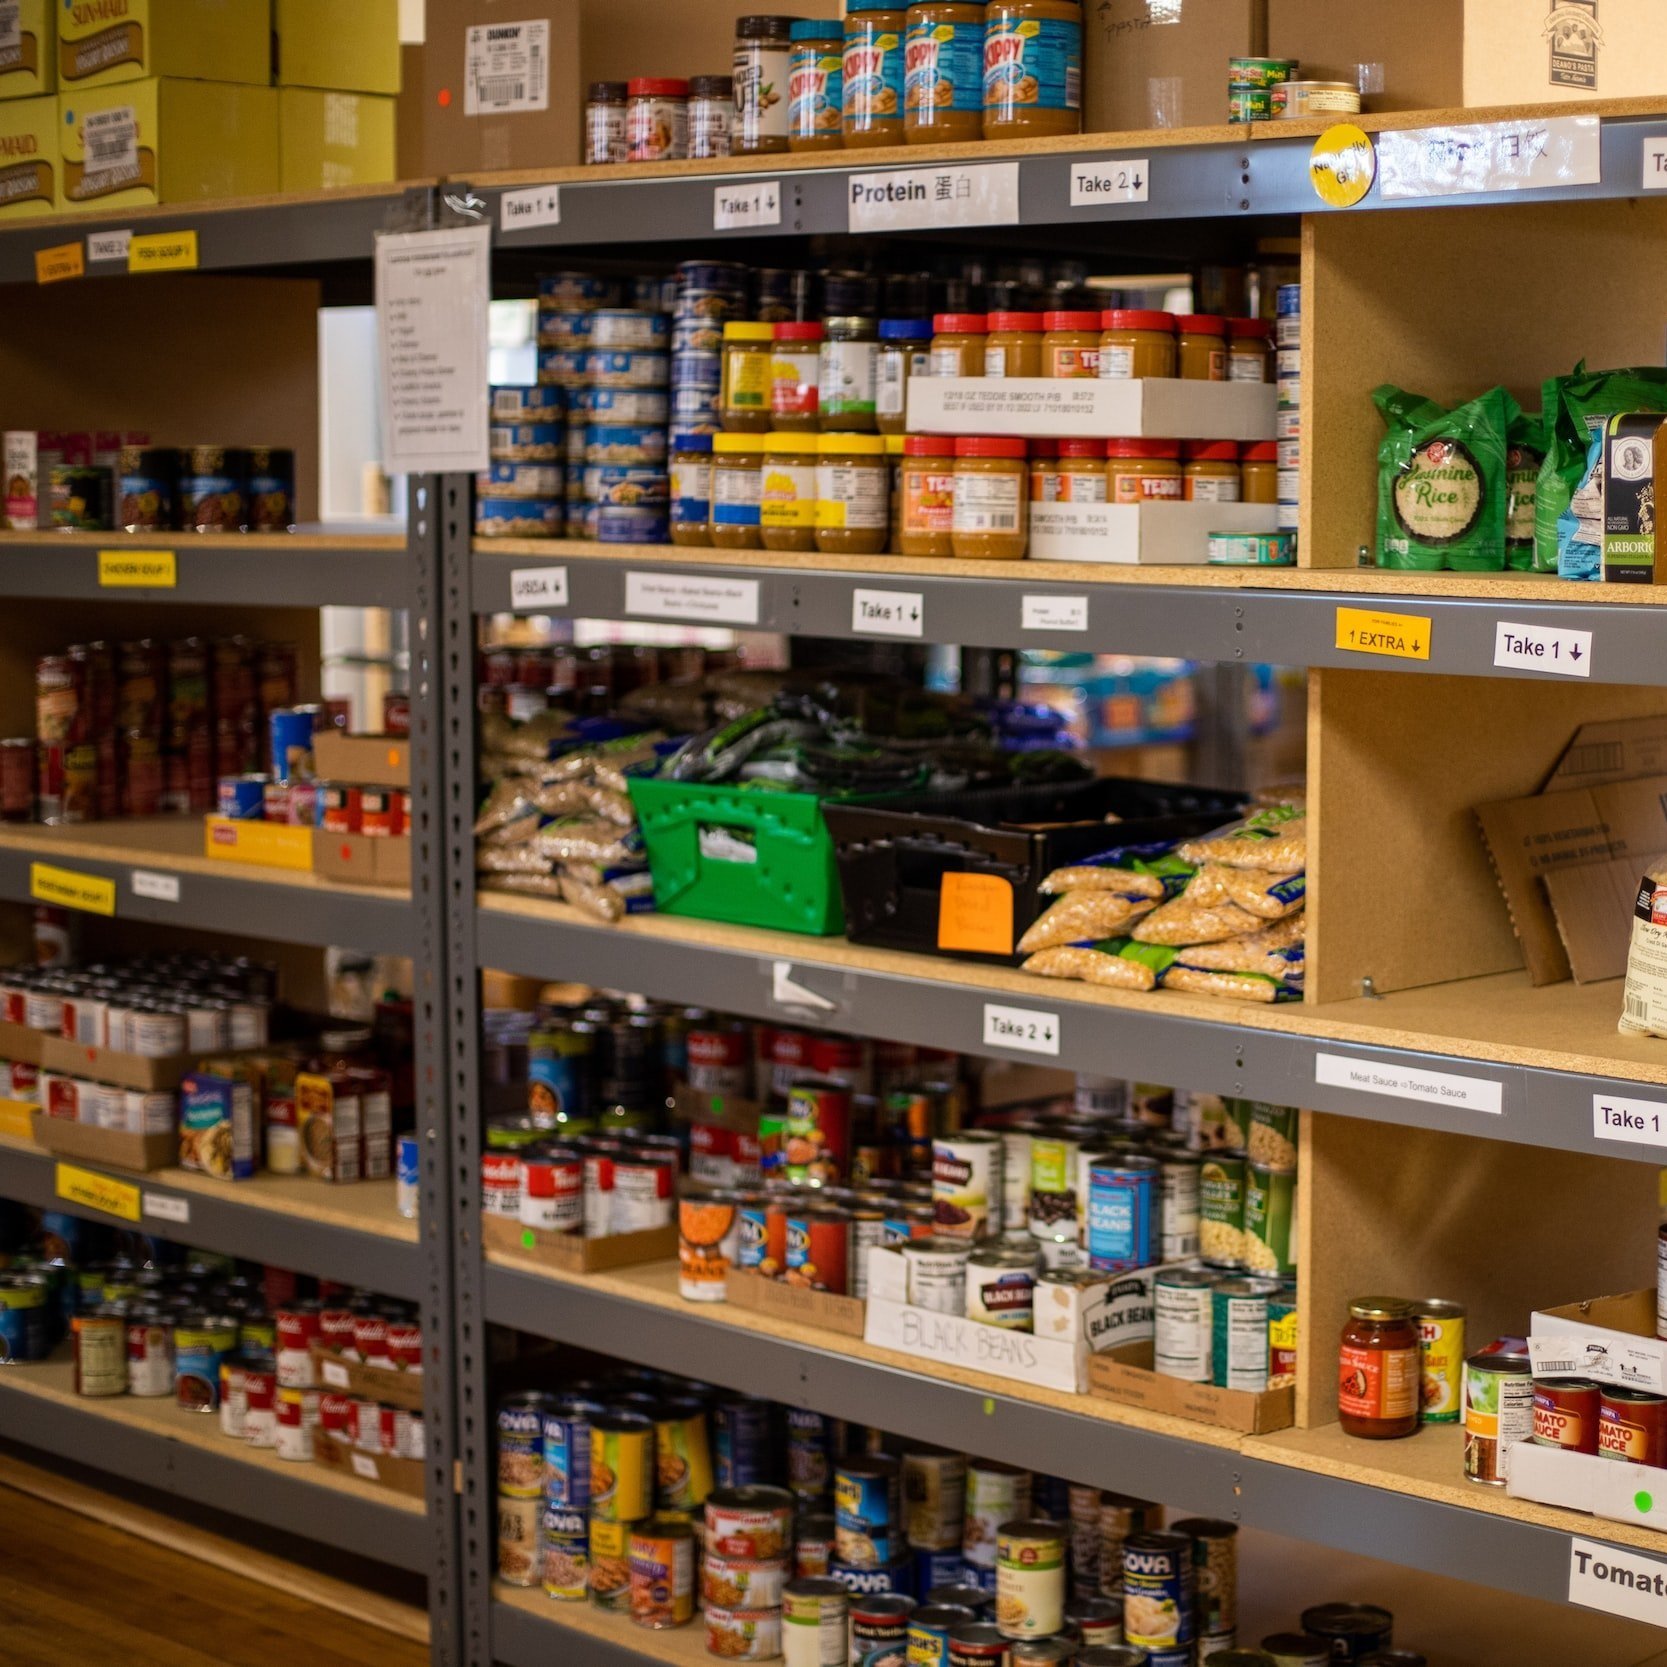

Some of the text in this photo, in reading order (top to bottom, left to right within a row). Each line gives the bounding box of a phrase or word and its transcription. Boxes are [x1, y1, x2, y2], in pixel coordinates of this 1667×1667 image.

[1577, 63, 1595, 73] PASTA
[851, 179, 926, 204] Protein
[1077, 172, 1130, 193] Take 2
[506, 200, 542, 216] Take 1
[720, 198, 760, 214] Take 1
[1399, 464, 1473, 489] Jasmine
[1415, 481, 1458, 508] Rice
[515, 579, 549, 597] USDA
[861, 601, 903, 621] Take 1
[1349, 630, 1405, 651] 1 EXTRA
[1504, 634, 1560, 659] Take 1
[991, 1016, 1038, 1040] Take 2
[1350, 1070, 1467, 1099] Meat Sauce Tomato Sauce
[1601, 1106, 1660, 1132] Take 1
[983, 1289, 1014, 1304] BLACK
[1090, 1303, 1155, 1337] BLACK BEAN
[902, 1310, 1037, 1368] BLACK BEANS
[1534, 1414, 1568, 1429] MATO
[1534, 1426, 1560, 1440] AUCE
[1600, 1424, 1633, 1442] MATO
[1600, 1437, 1627, 1452] AUCE
[1126, 1554, 1170, 1574] OYA
